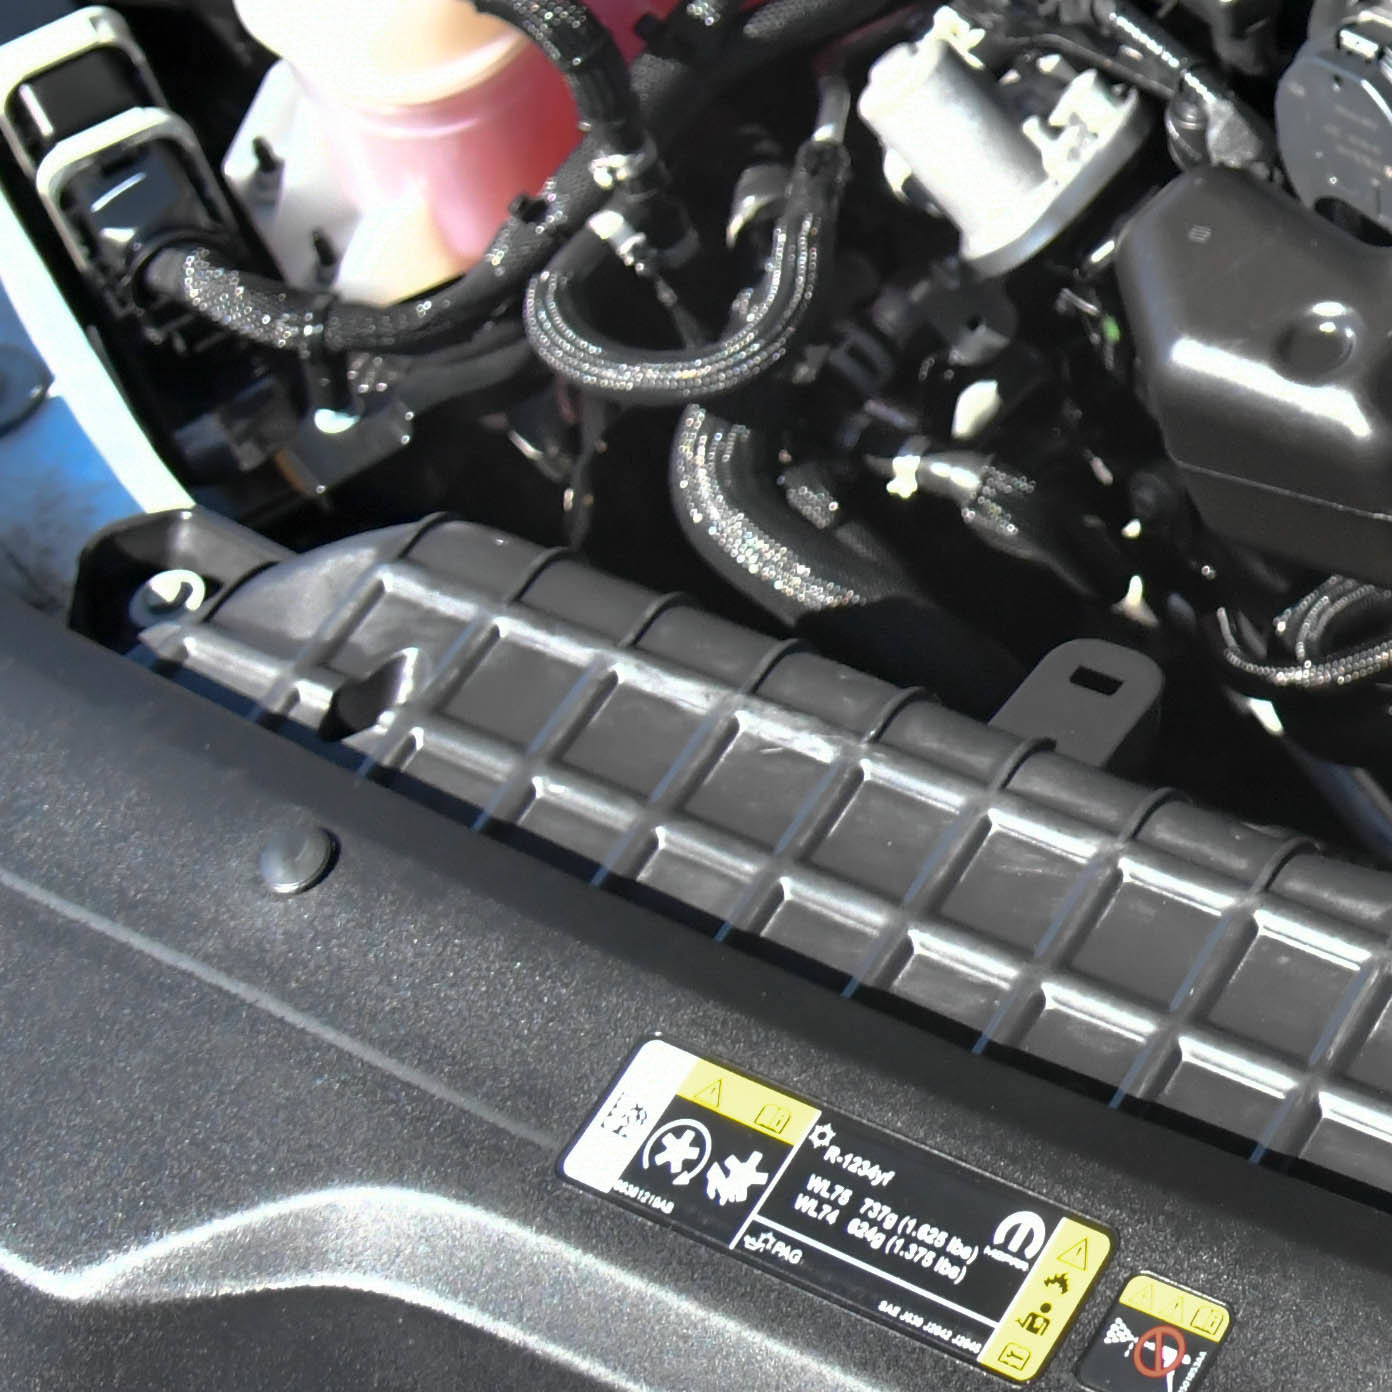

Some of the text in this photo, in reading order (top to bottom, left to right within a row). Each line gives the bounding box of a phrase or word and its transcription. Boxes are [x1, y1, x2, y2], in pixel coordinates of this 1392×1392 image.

[823, 1145, 896, 1187] R-1234yf
[794, 1192, 841, 1225] WL74
[858, 1197, 899, 1231] 737g
[771, 1240, 803, 1264] PAG
